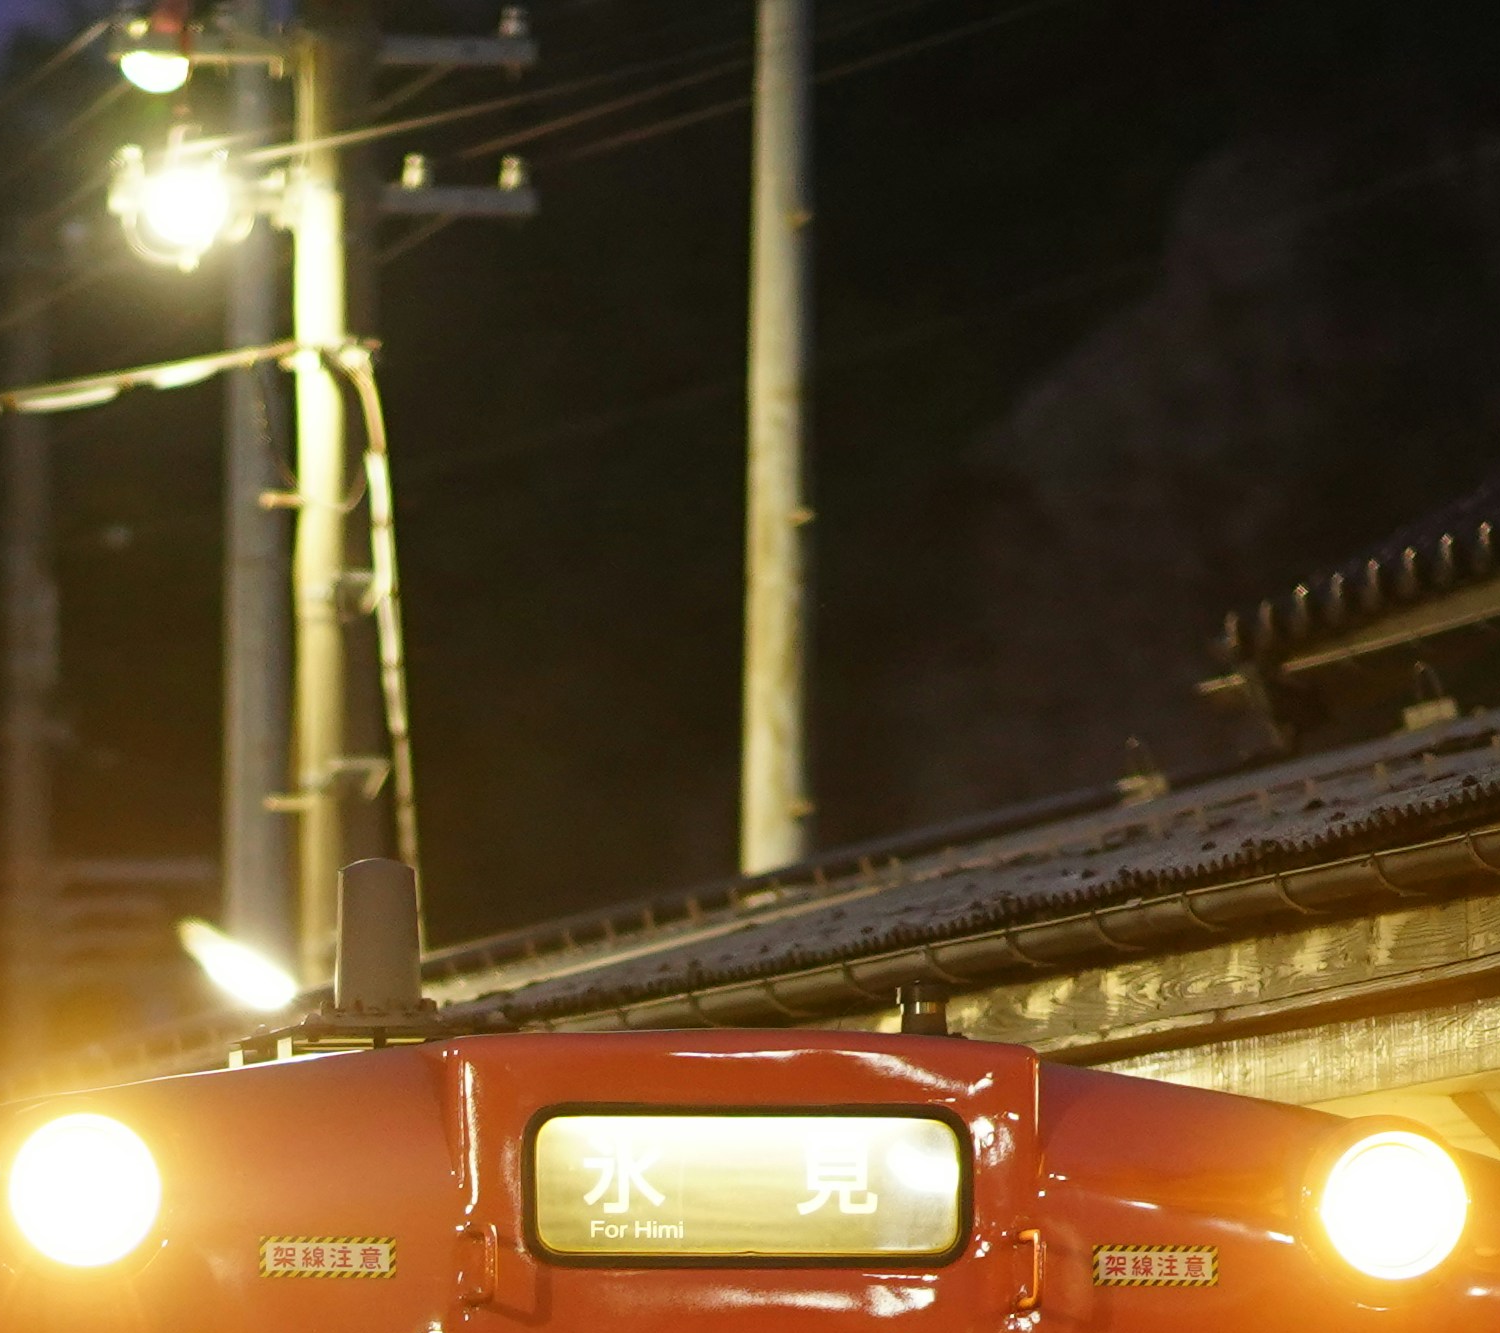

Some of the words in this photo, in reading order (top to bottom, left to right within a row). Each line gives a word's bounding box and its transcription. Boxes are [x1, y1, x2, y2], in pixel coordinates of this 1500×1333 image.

[590, 1220, 629, 1239] For
[634, 1220, 684, 1239] Himi
[272, 1245, 383, 1270] 架線注意
[1104, 1254, 1206, 1278] 架線注意
